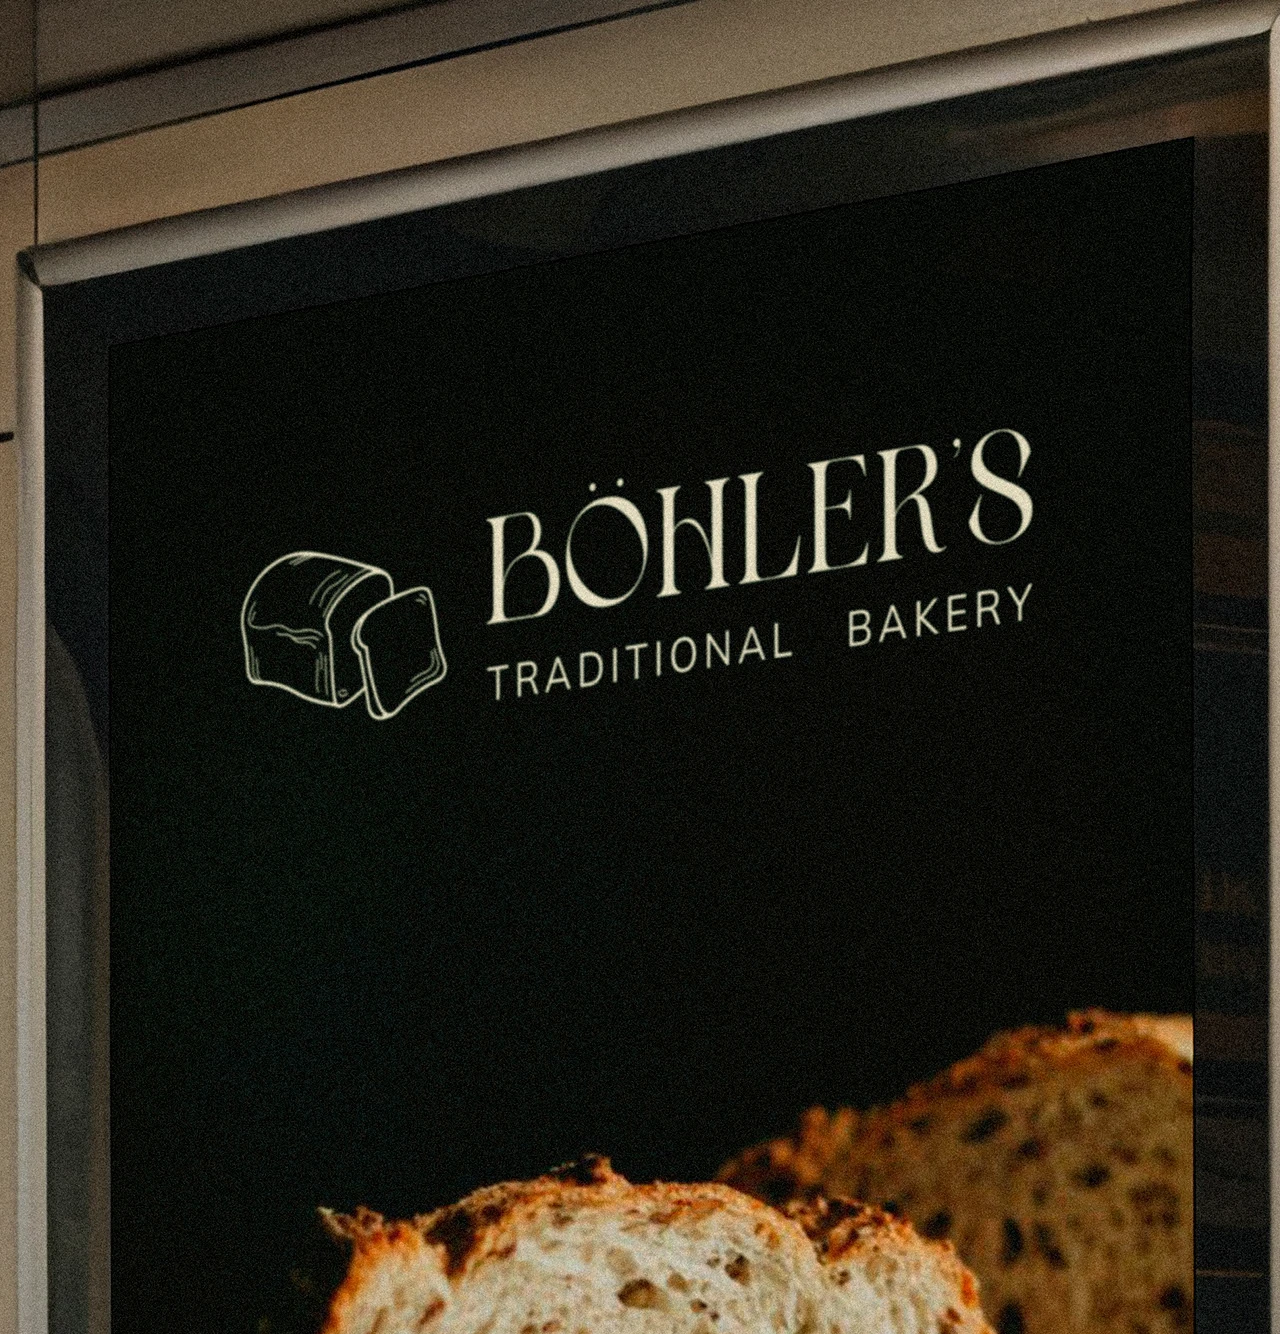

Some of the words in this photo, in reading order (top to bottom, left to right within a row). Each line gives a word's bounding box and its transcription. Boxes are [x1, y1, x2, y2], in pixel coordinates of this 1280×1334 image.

[486, 429, 1035, 626] BÖHLER'S
[486, 622, 794, 700] TRADITIONAL
[848, 583, 1034, 649] BAKERY
